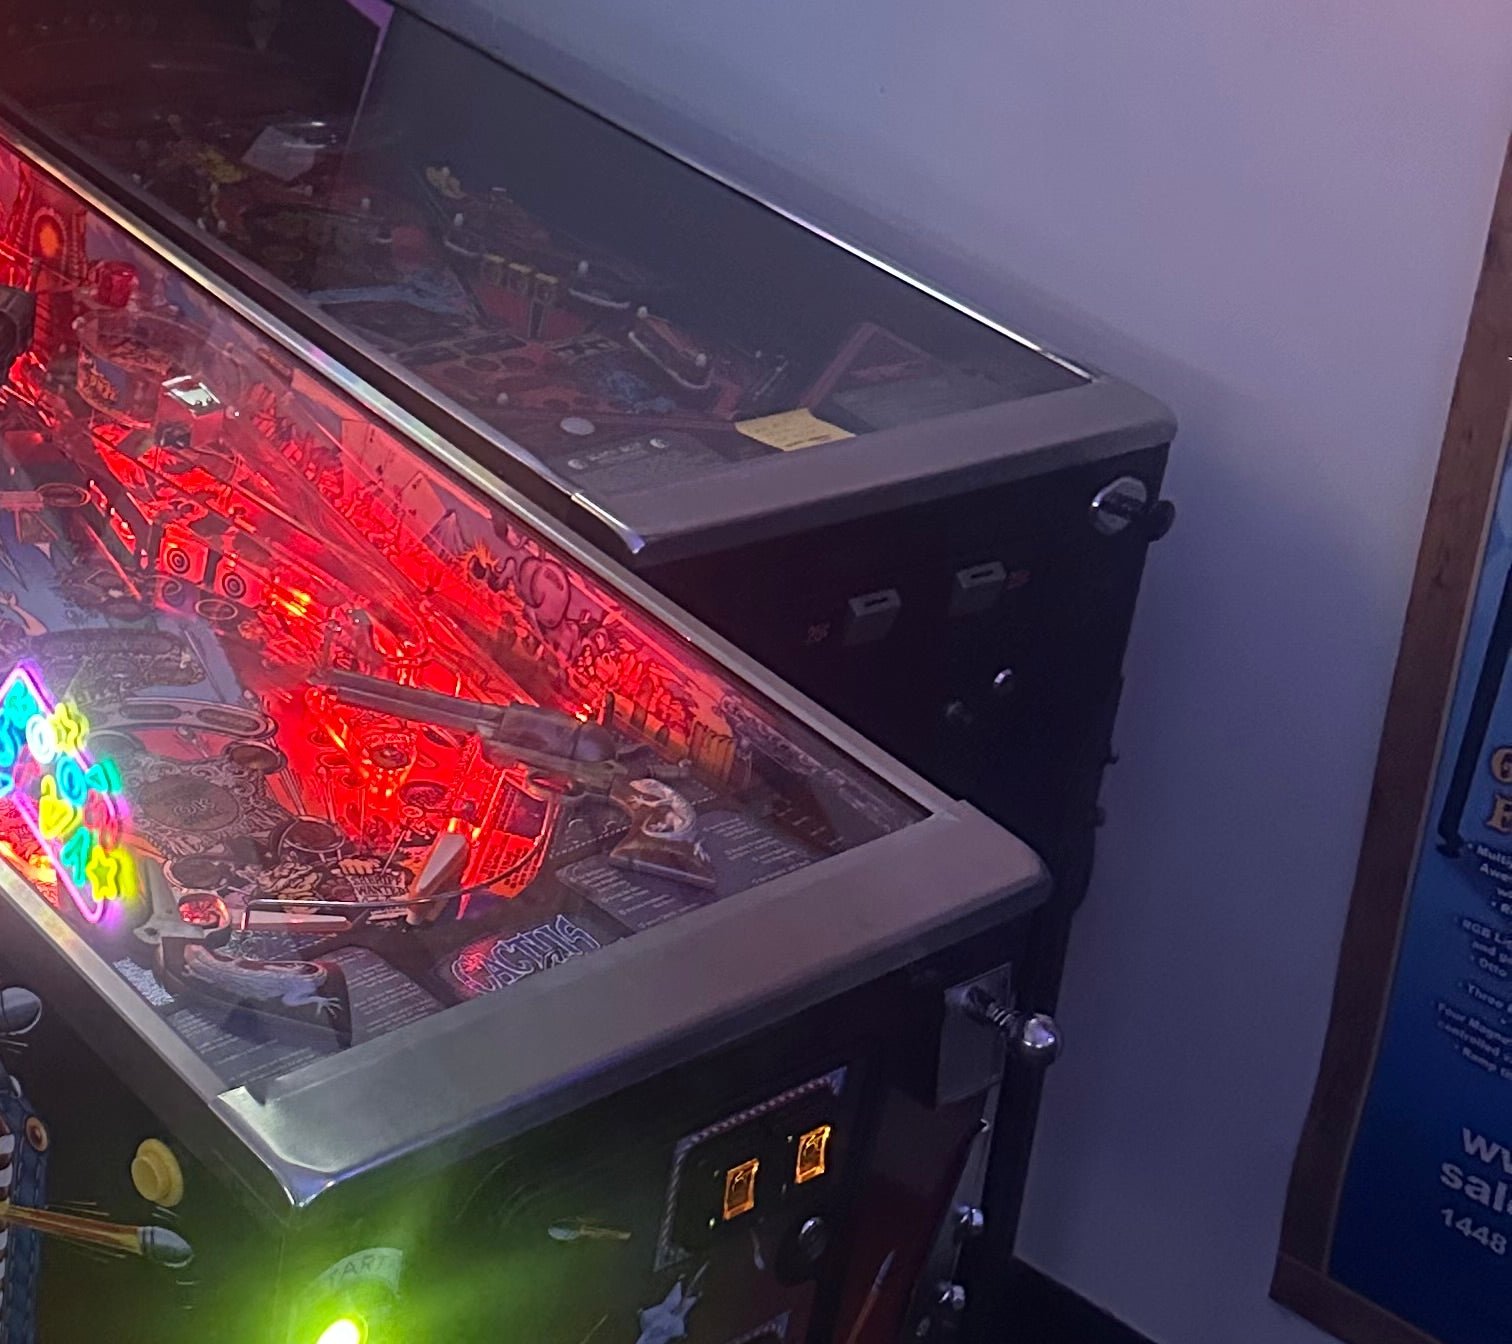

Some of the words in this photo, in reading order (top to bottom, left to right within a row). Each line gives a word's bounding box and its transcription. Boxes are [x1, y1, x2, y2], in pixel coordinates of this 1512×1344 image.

[450, 913, 601, 994] CACTUS
[1440, 1207, 1507, 1256] 1448
[322, 1253, 394, 1290] TART
